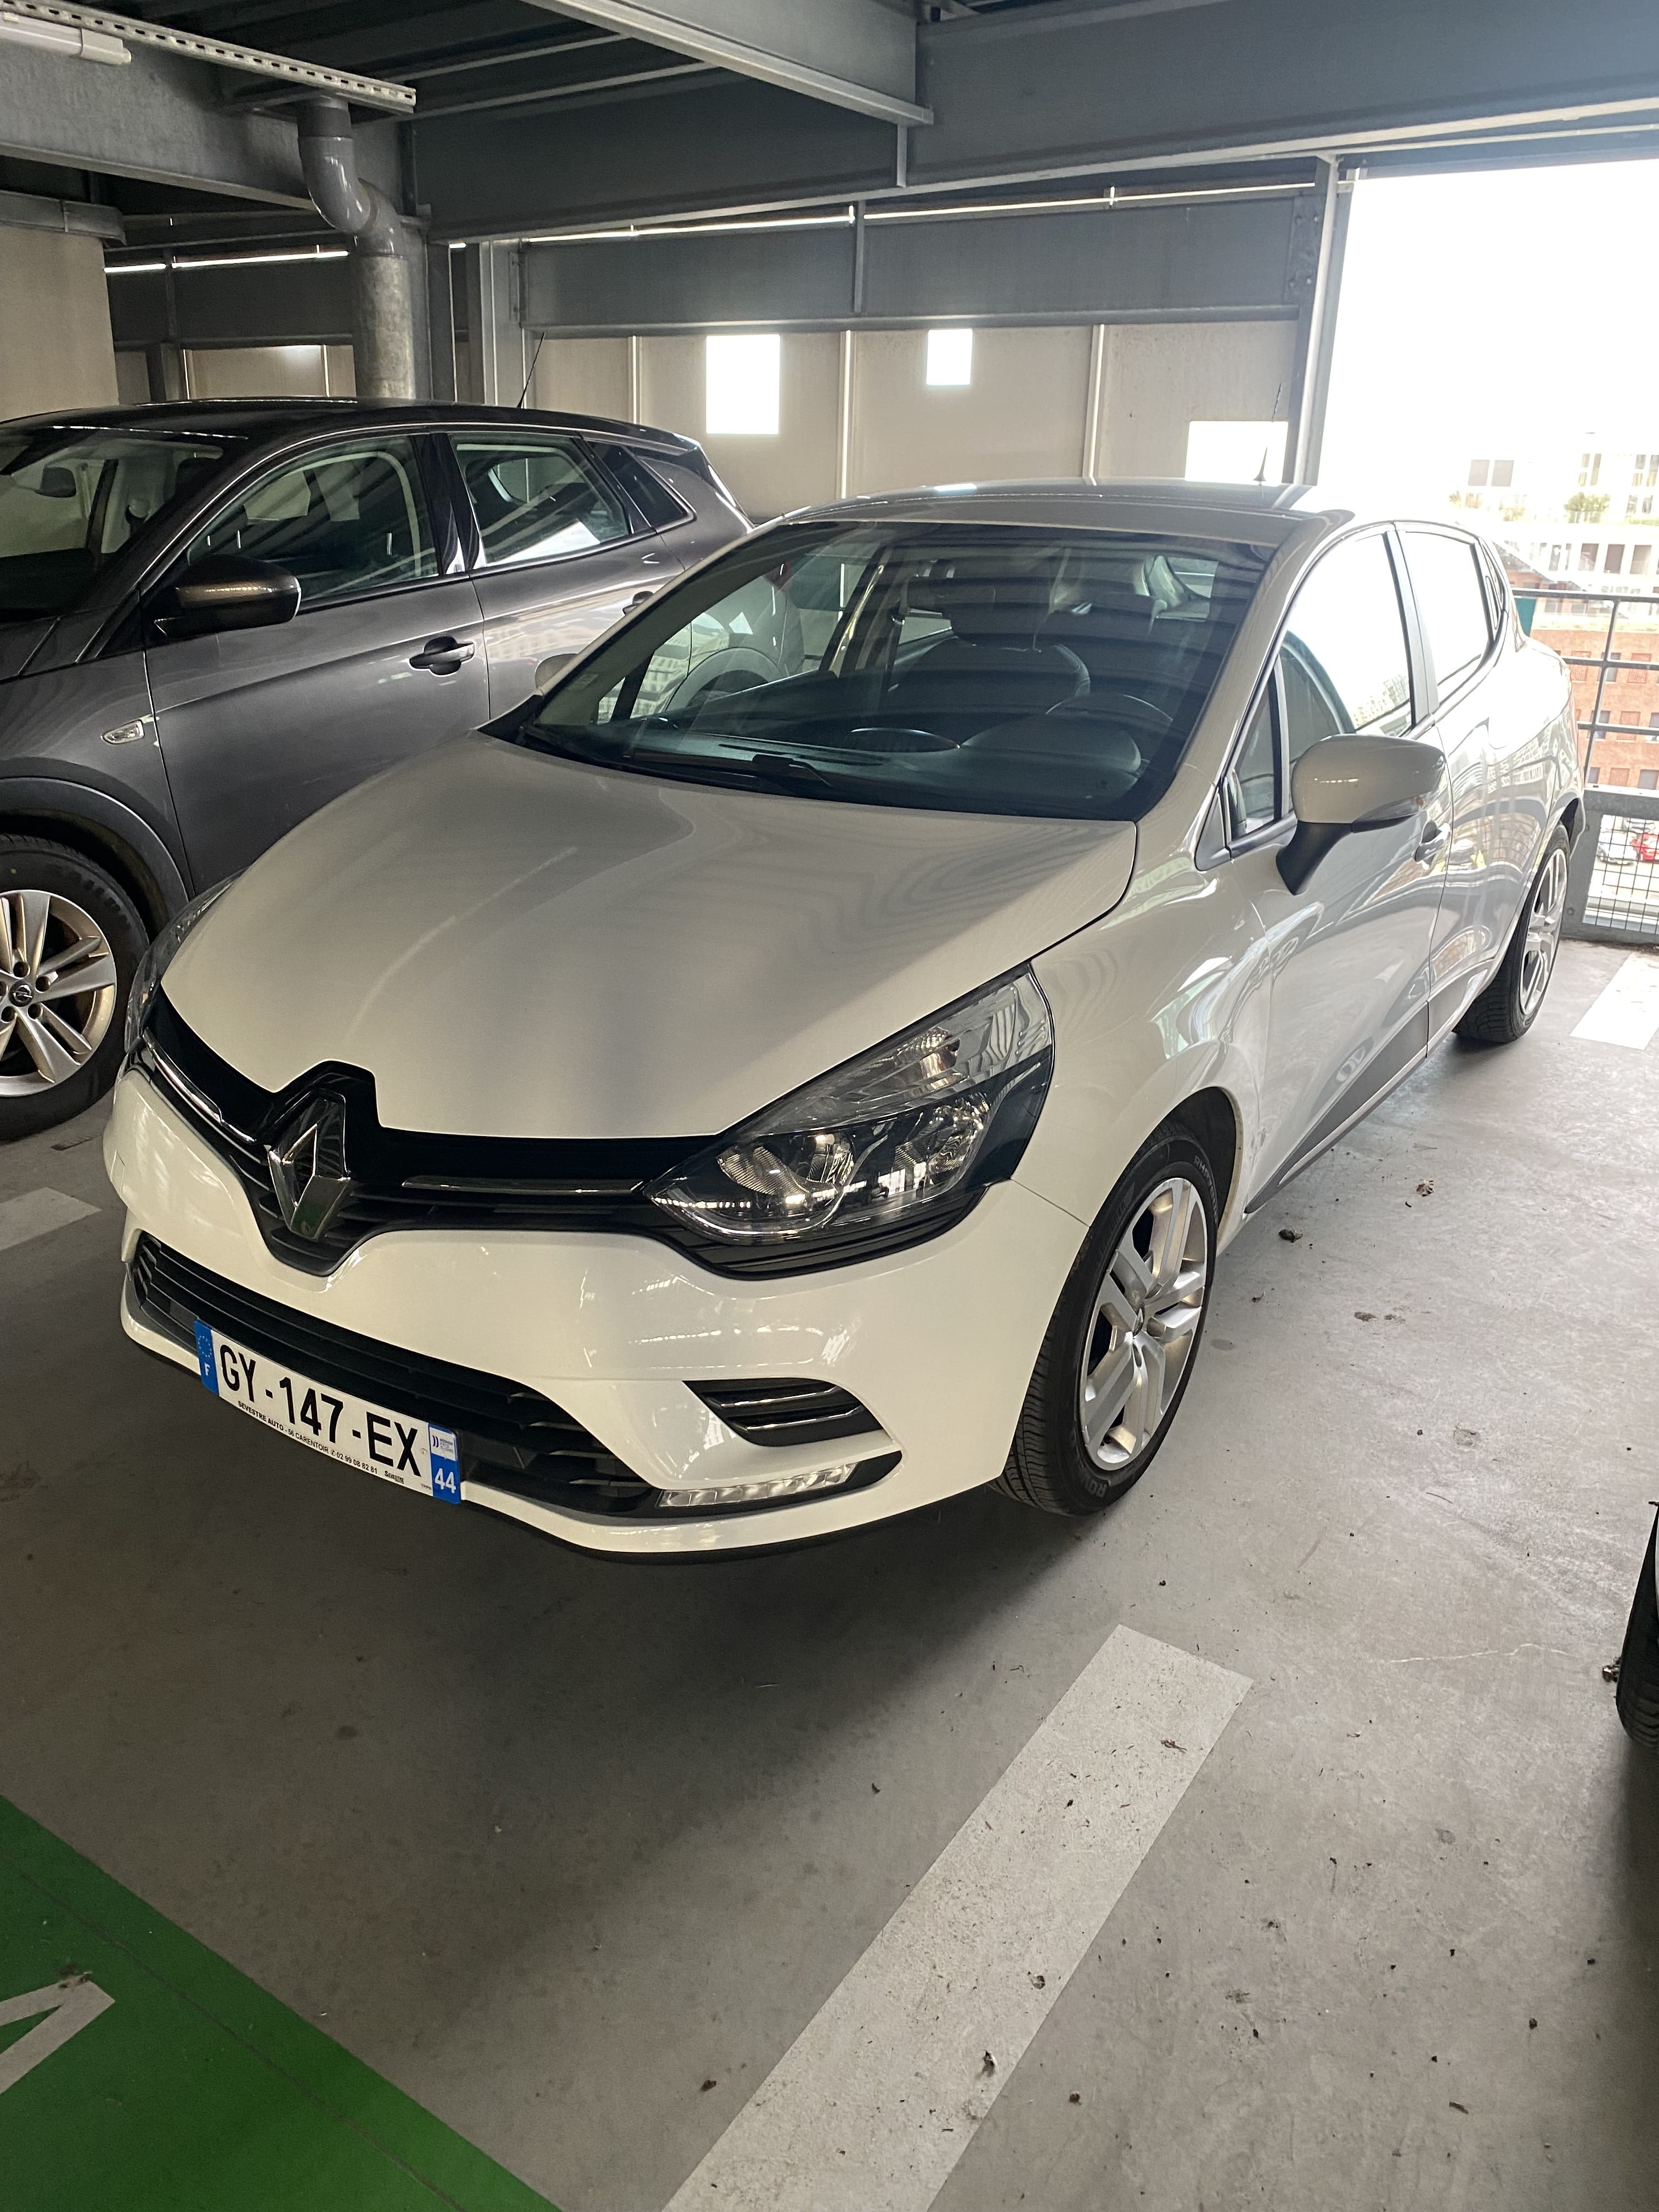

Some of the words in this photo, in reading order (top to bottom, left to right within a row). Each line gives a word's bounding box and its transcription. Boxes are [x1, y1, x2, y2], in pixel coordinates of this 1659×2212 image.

[204, 1363, 211, 1376] F
[220, 1345, 421, 1477] GY-147-EX
[238, 1401, 267, 1421] SEVESTRE
[268, 1418, 283, 1430] AUTO
[296, 1432, 329, 1453] CARENTOIR
[336, 1452, 343, 1460] 02
[435, 1468, 456, 1494] 44
